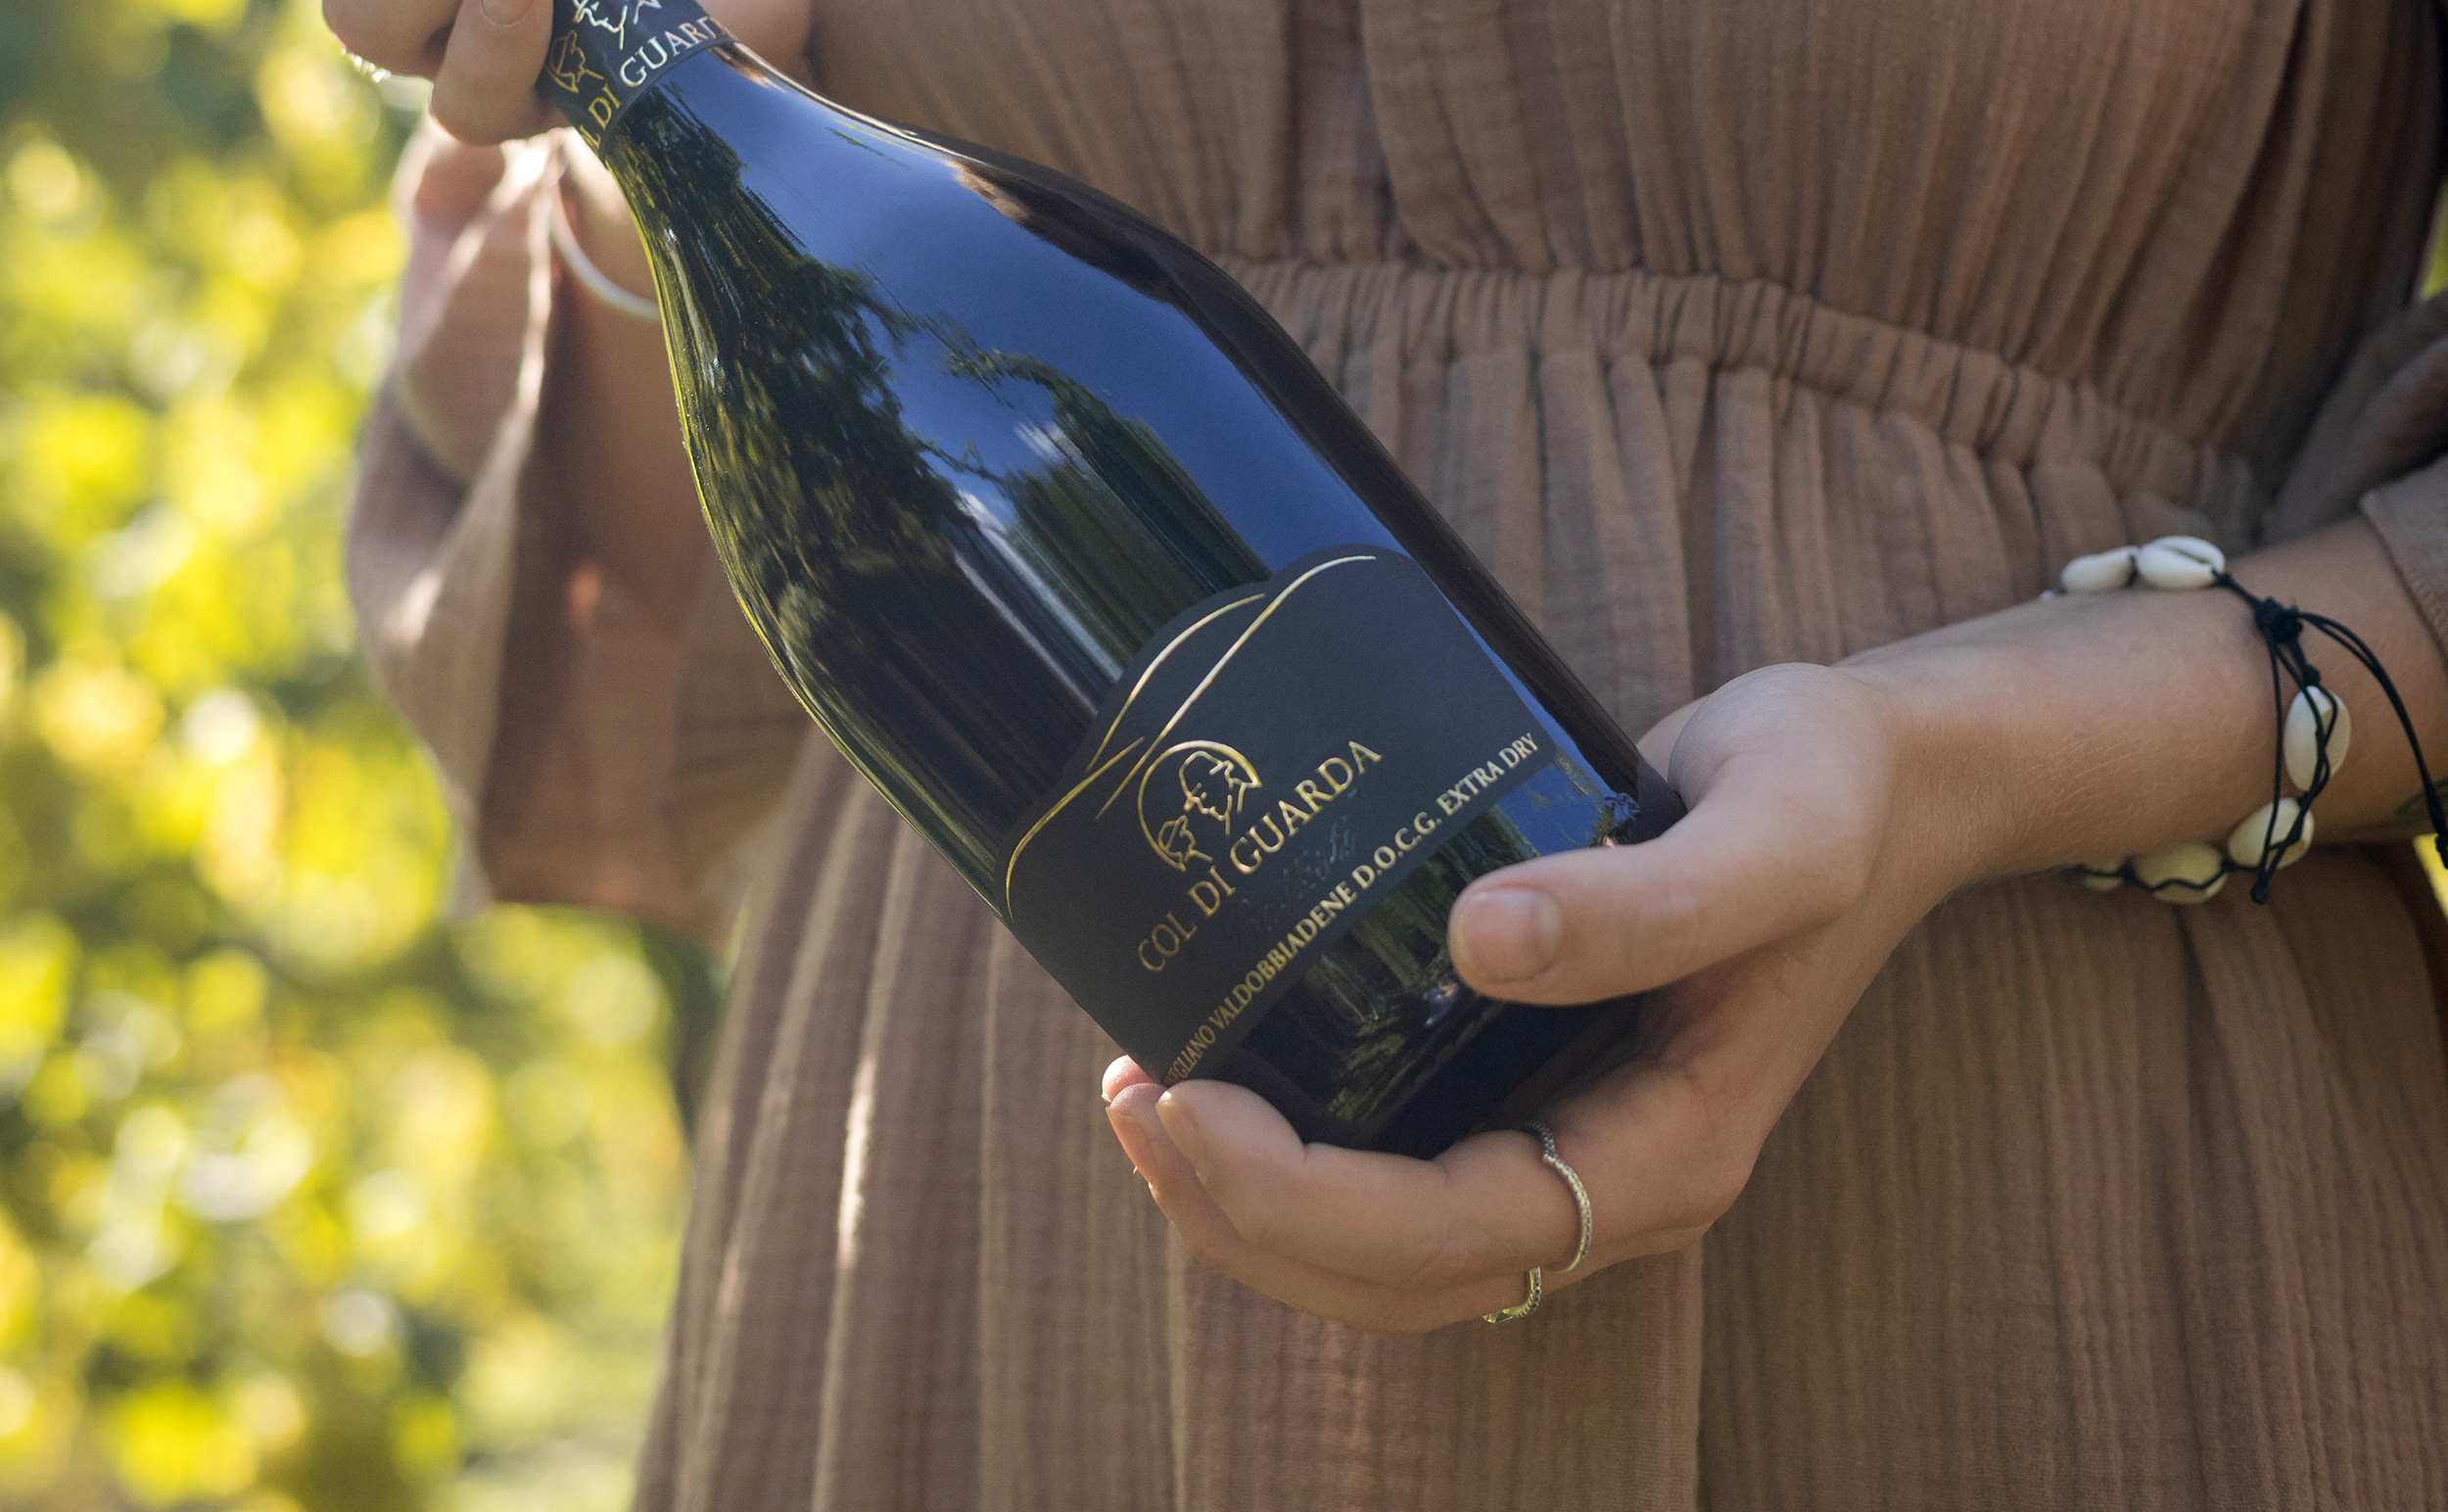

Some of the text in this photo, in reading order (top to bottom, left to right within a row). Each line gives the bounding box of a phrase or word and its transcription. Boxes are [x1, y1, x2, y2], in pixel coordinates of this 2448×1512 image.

[588, 82, 621, 130] DI
[1138, 740, 1383, 971] COL DI GUARDA
[1208, 880, 1358, 1029] VALDOBBIADENE
[1351, 812, 1442, 889] D.O.C.G.
[1436, 760, 1505, 817] EXTRA
[1498, 732, 1538, 769] DRY
